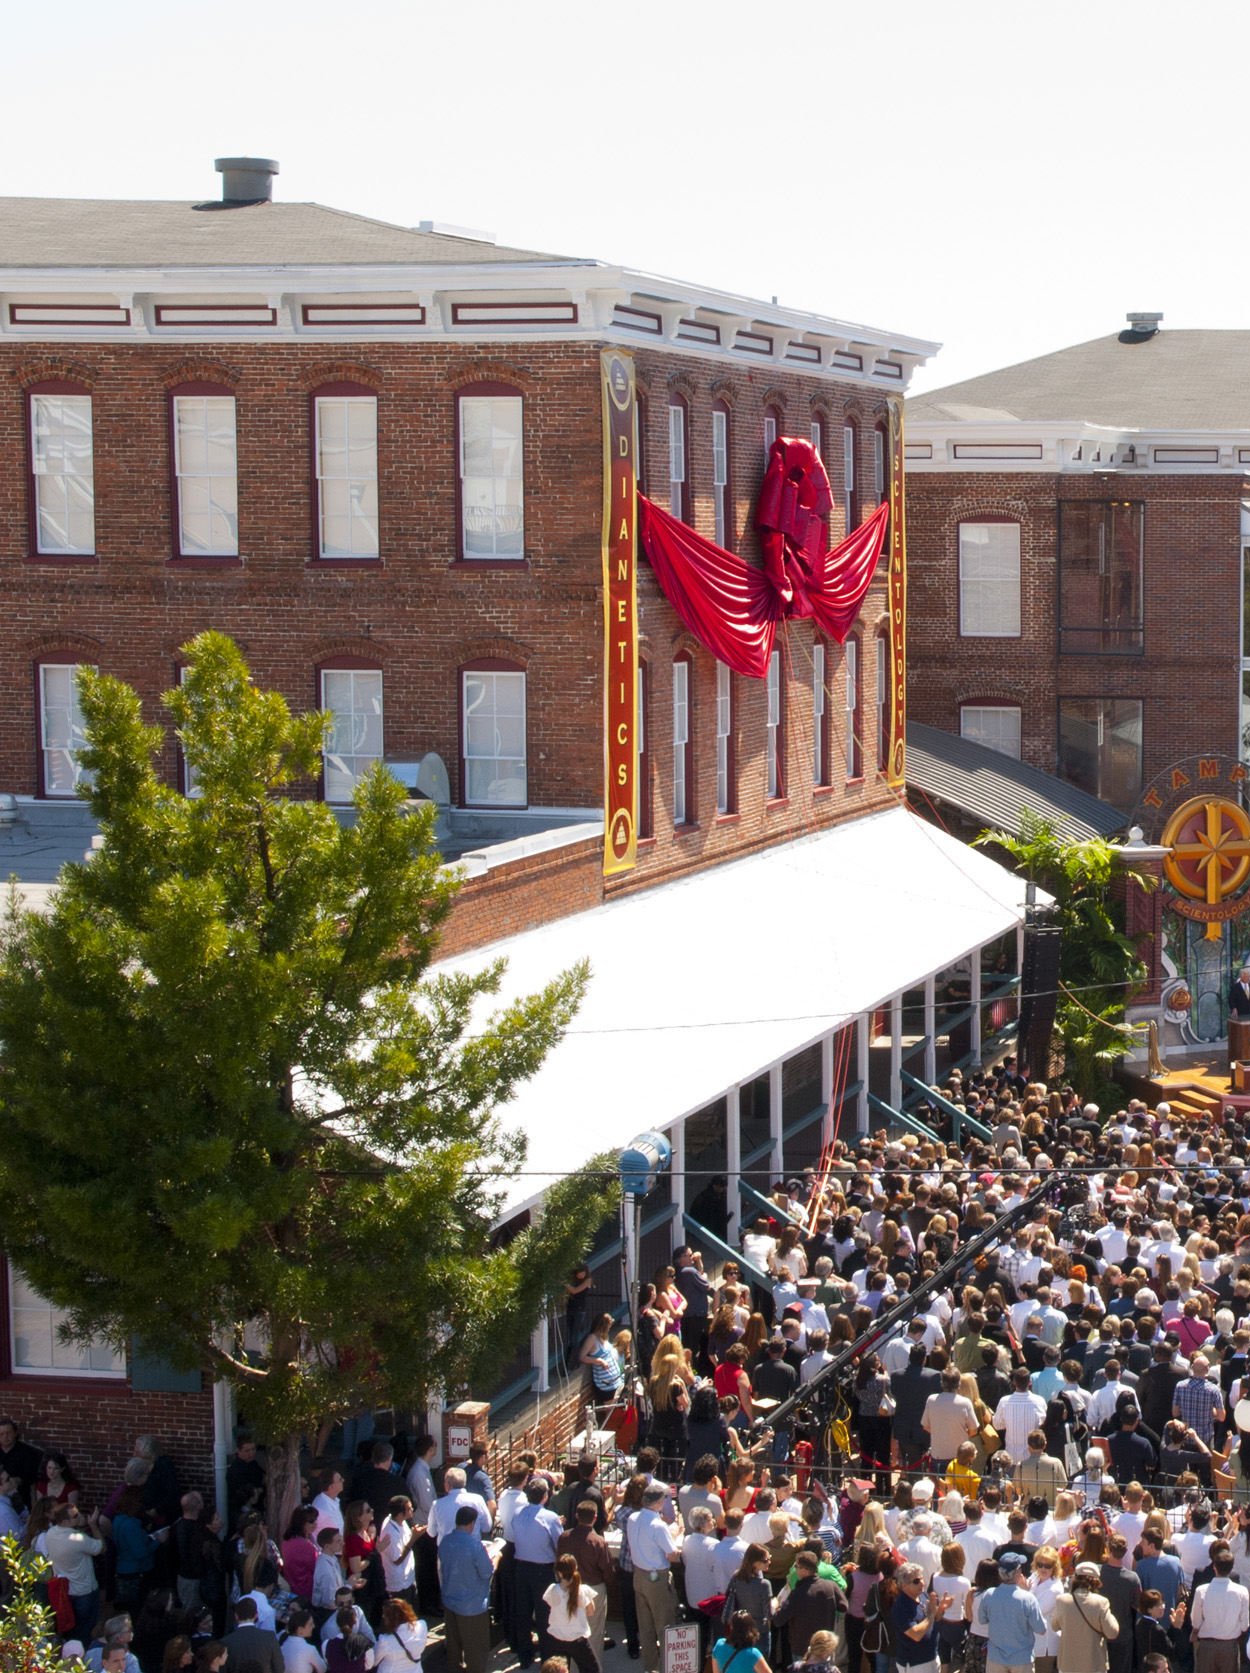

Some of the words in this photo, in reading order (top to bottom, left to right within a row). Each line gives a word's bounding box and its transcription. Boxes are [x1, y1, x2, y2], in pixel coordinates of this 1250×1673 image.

[893, 454, 905, 727] SCIENTOLOGY
[617, 435, 629, 786] DIANETICS
[451, 1437, 469, 1447] FDC
[677, 1630, 687, 1639] NO
[667, 1640, 696, 1651] PARKING
[675, 1652, 689, 1661] THIS
[672, 1662, 691, 1673] SPACE
